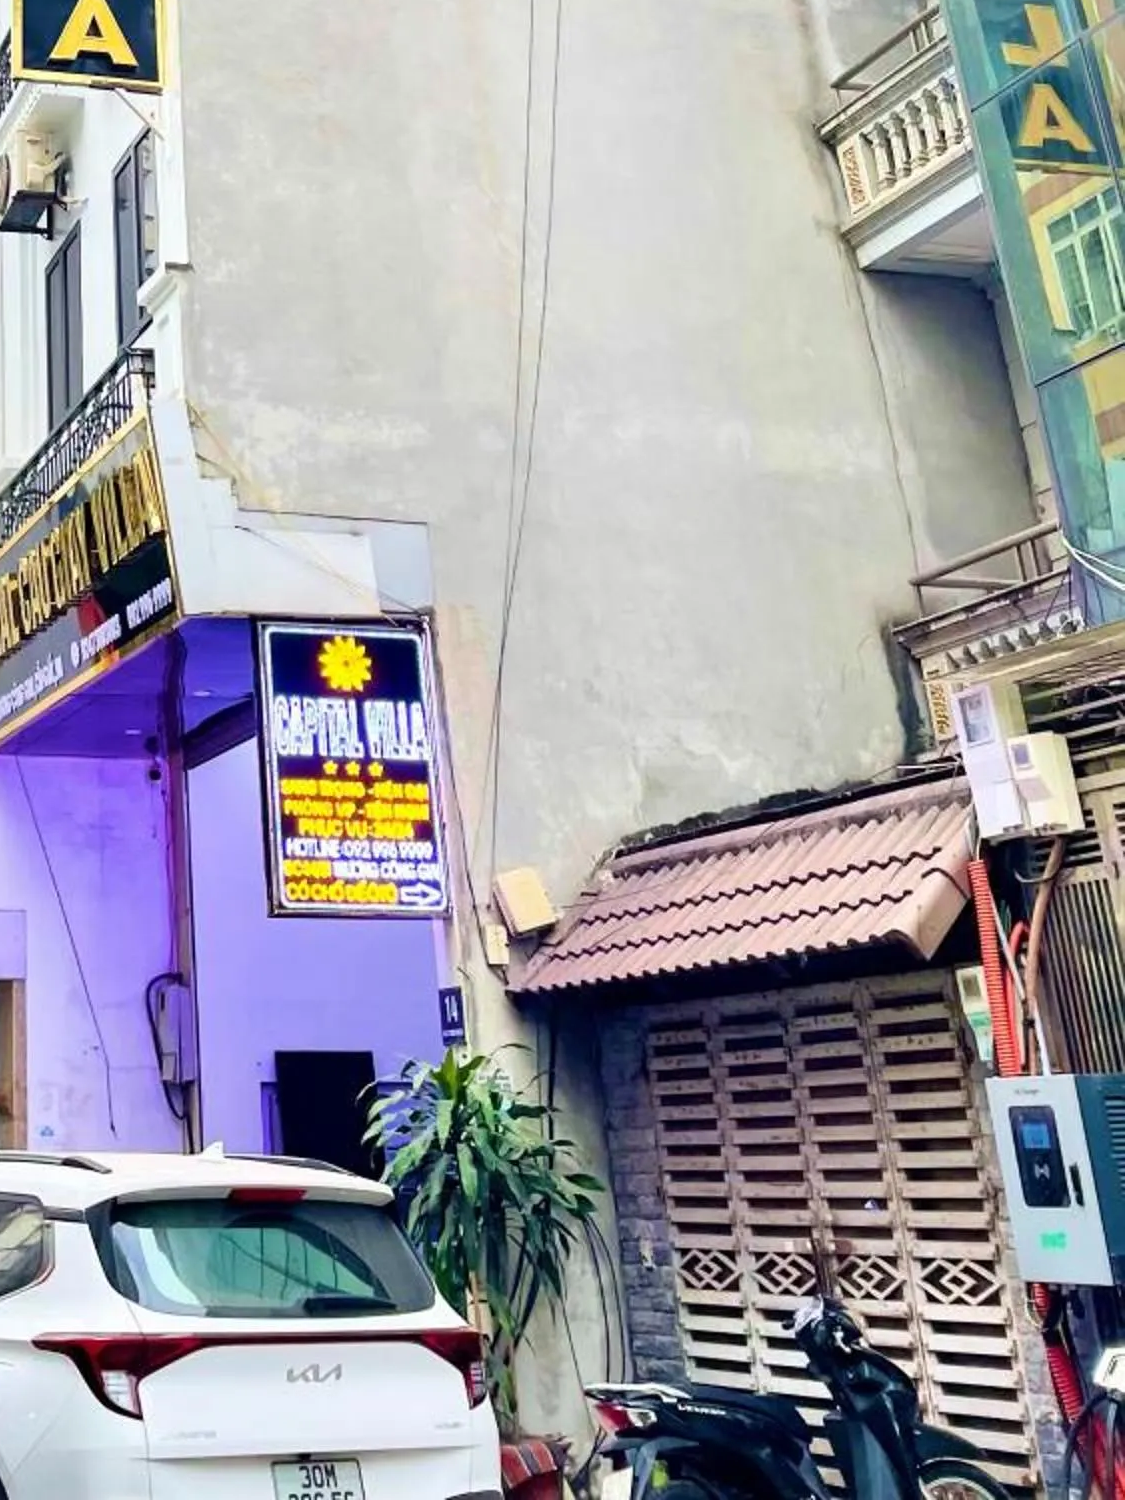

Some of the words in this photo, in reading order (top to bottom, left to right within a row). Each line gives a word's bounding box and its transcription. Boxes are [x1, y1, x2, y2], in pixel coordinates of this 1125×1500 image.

[276, 694, 364, 758] CAPITAL
[363, 699, 431, 761] VILLA
[286, 1363, 343, 1384] KIA
[298, 1464, 339, 1489] 30M
